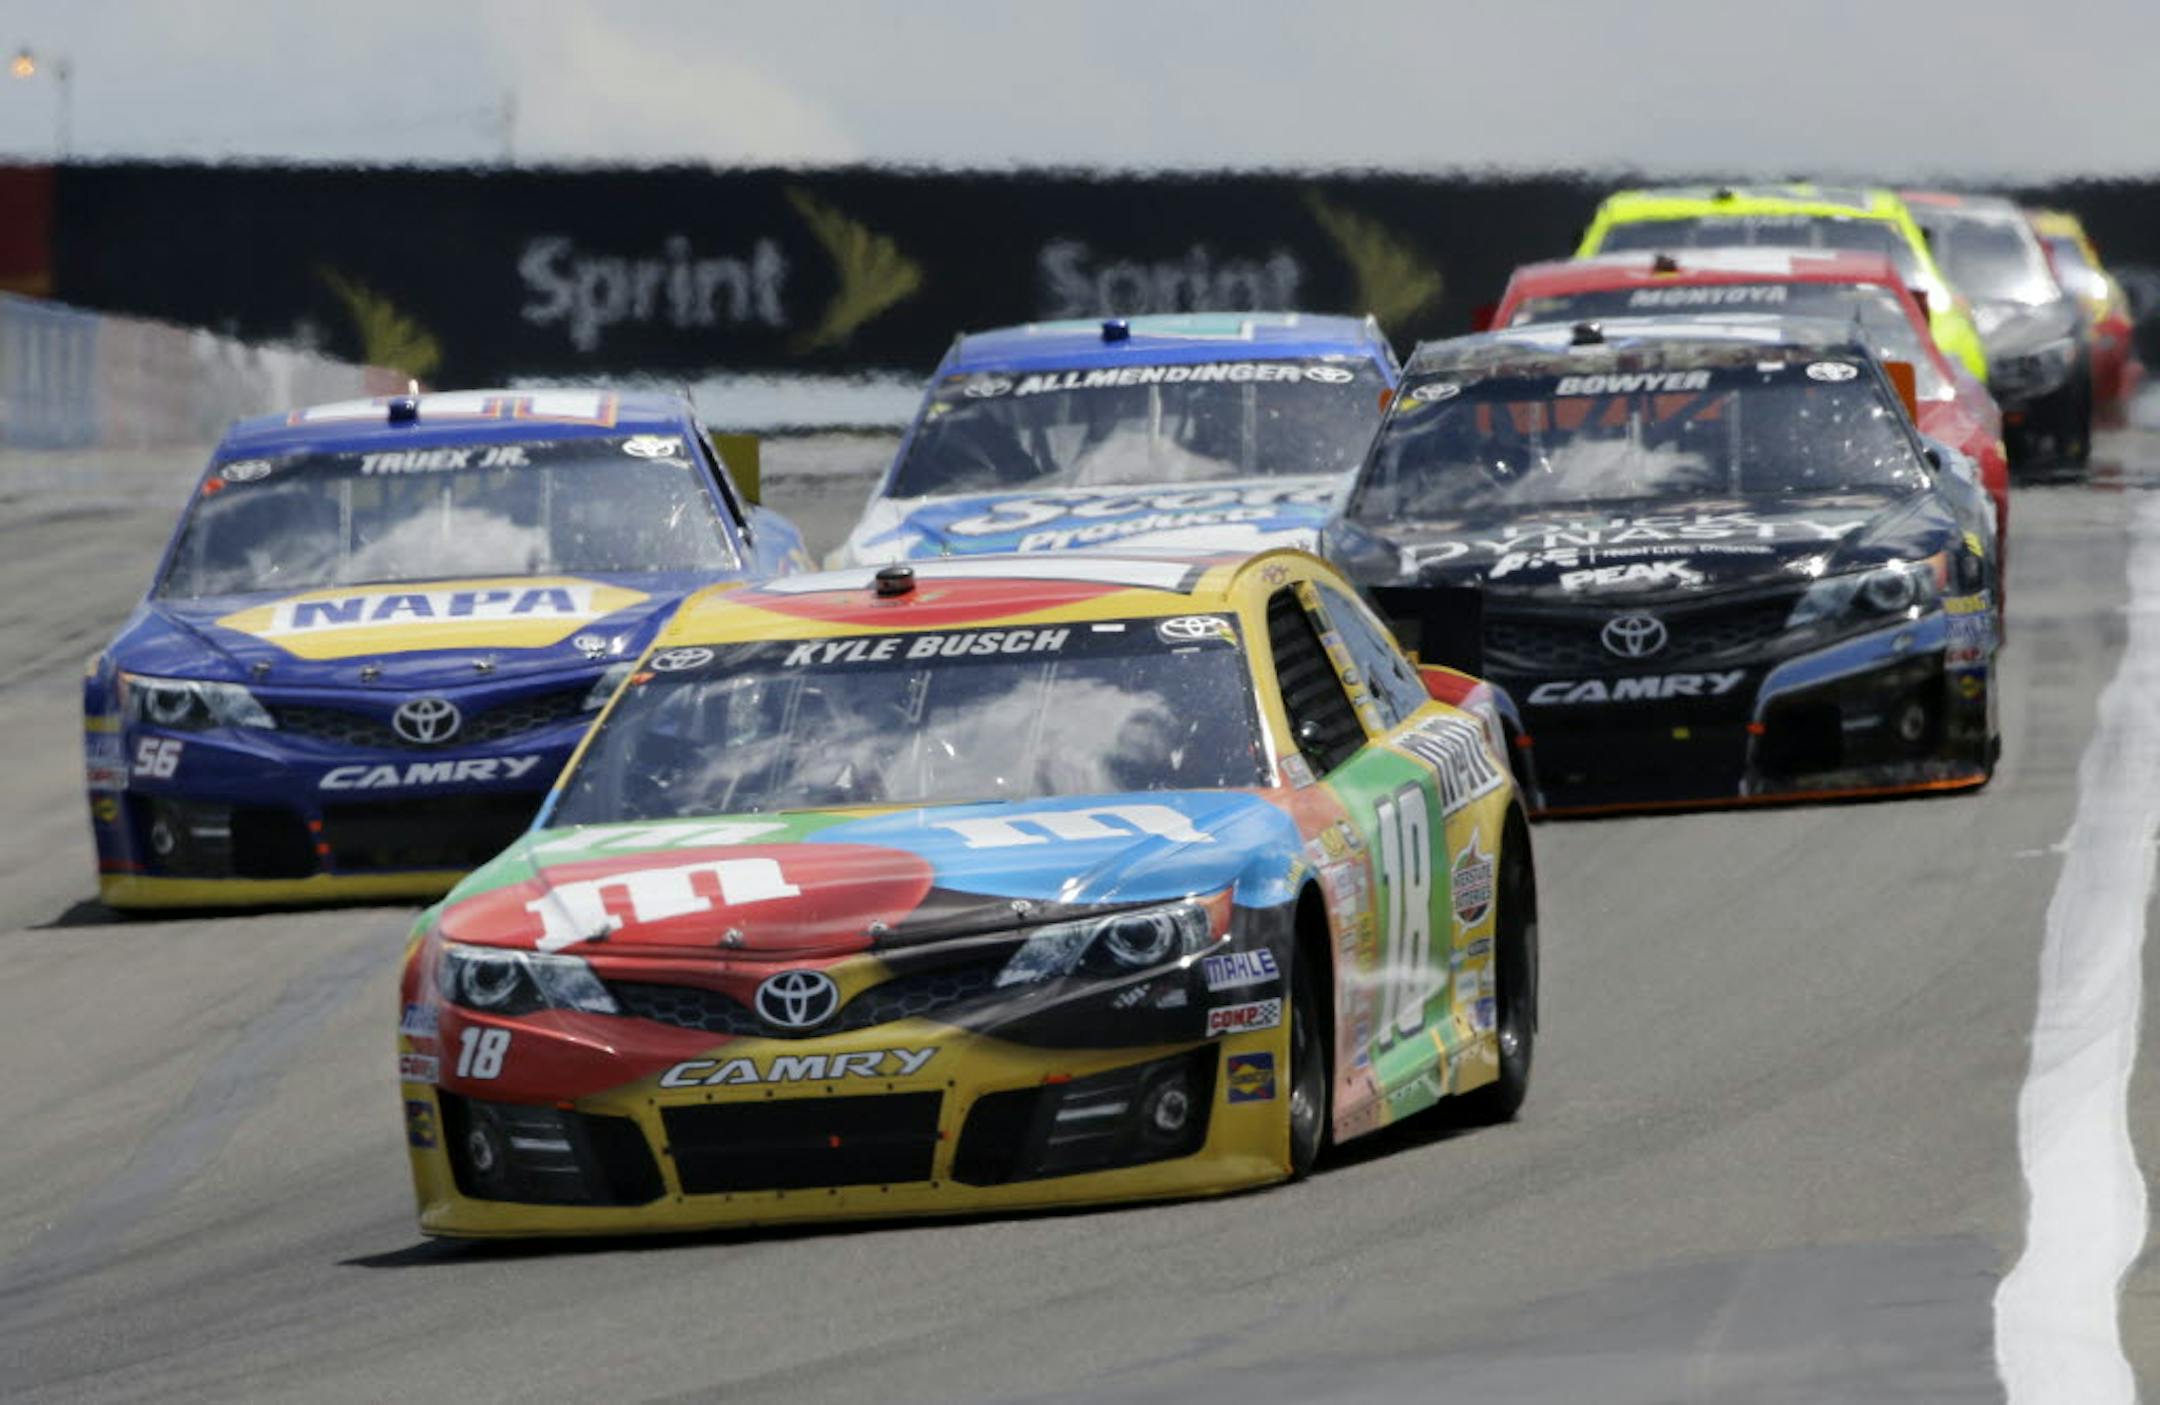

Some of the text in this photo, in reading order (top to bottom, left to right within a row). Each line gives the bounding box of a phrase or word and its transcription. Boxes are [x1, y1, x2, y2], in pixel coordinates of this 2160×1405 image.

[518, 235, 787, 351] Sprint
[1629, 286, 1788, 307] MONTOYA
[1013, 363, 1301, 396] ALLMENDINGER
[1555, 370, 1711, 396] BOWYER
[361, 446, 531, 475] TRUEX JR.
[1559, 559, 1692, 591] PEAK
[293, 588, 577, 628] NAPA
[783, 629, 1070, 666] KYLE BUSCH
[1527, 669, 1746, 704] CAMRY
[134, 737, 183, 778] 56
[318, 755, 541, 789] CAMRY
[527, 857, 801, 952] m
[1374, 779, 1432, 1050] 18
[1205, 951, 1277, 983] MAHLE
[1210, 1005, 1259, 1029] COMP
[456, 1027, 511, 1079] 18
[659, 1047, 939, 1088] CAMRY
